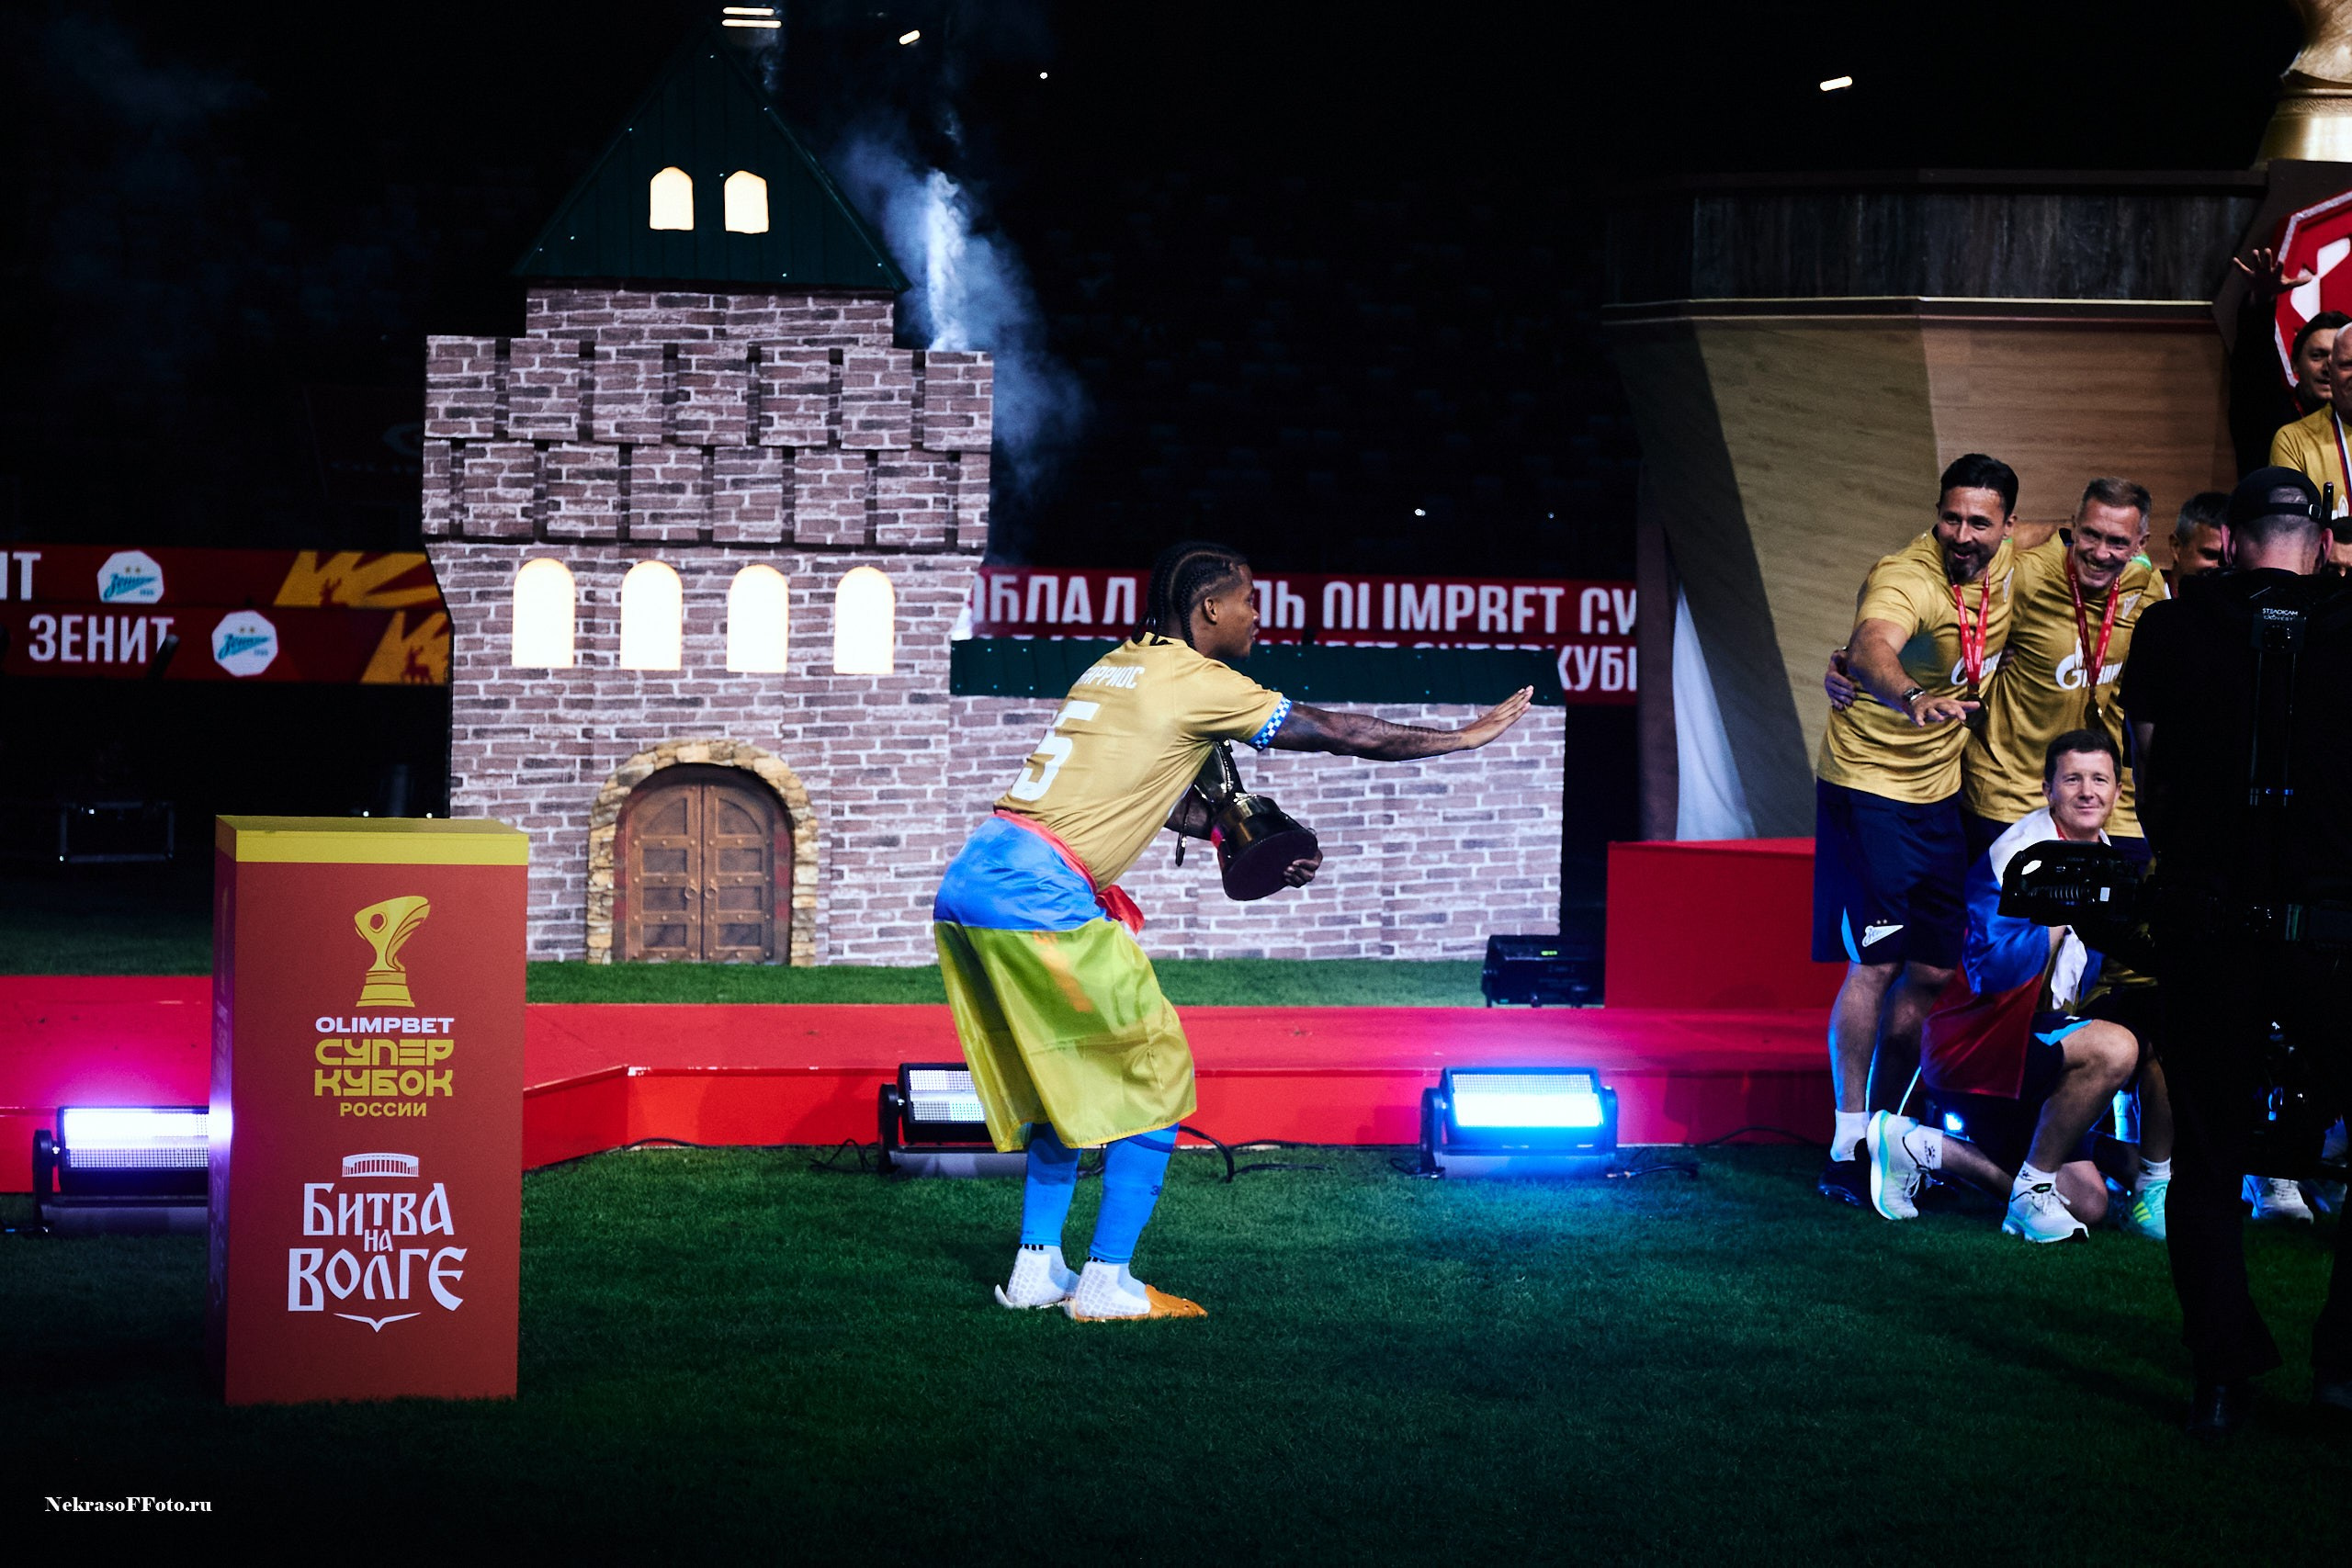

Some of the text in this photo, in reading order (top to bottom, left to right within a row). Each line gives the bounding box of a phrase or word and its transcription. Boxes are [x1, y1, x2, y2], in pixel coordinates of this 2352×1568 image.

[28, 615, 175, 664] ЗЕНИТ
[1011, 700, 1101, 801] 5
[315, 1017, 455, 1034] OLIMPBET
[314, 1039, 455, 1066] СУПЕР
[314, 1069, 454, 1097] КУБОК
[340, 1102, 427, 1117] РОССИИ
